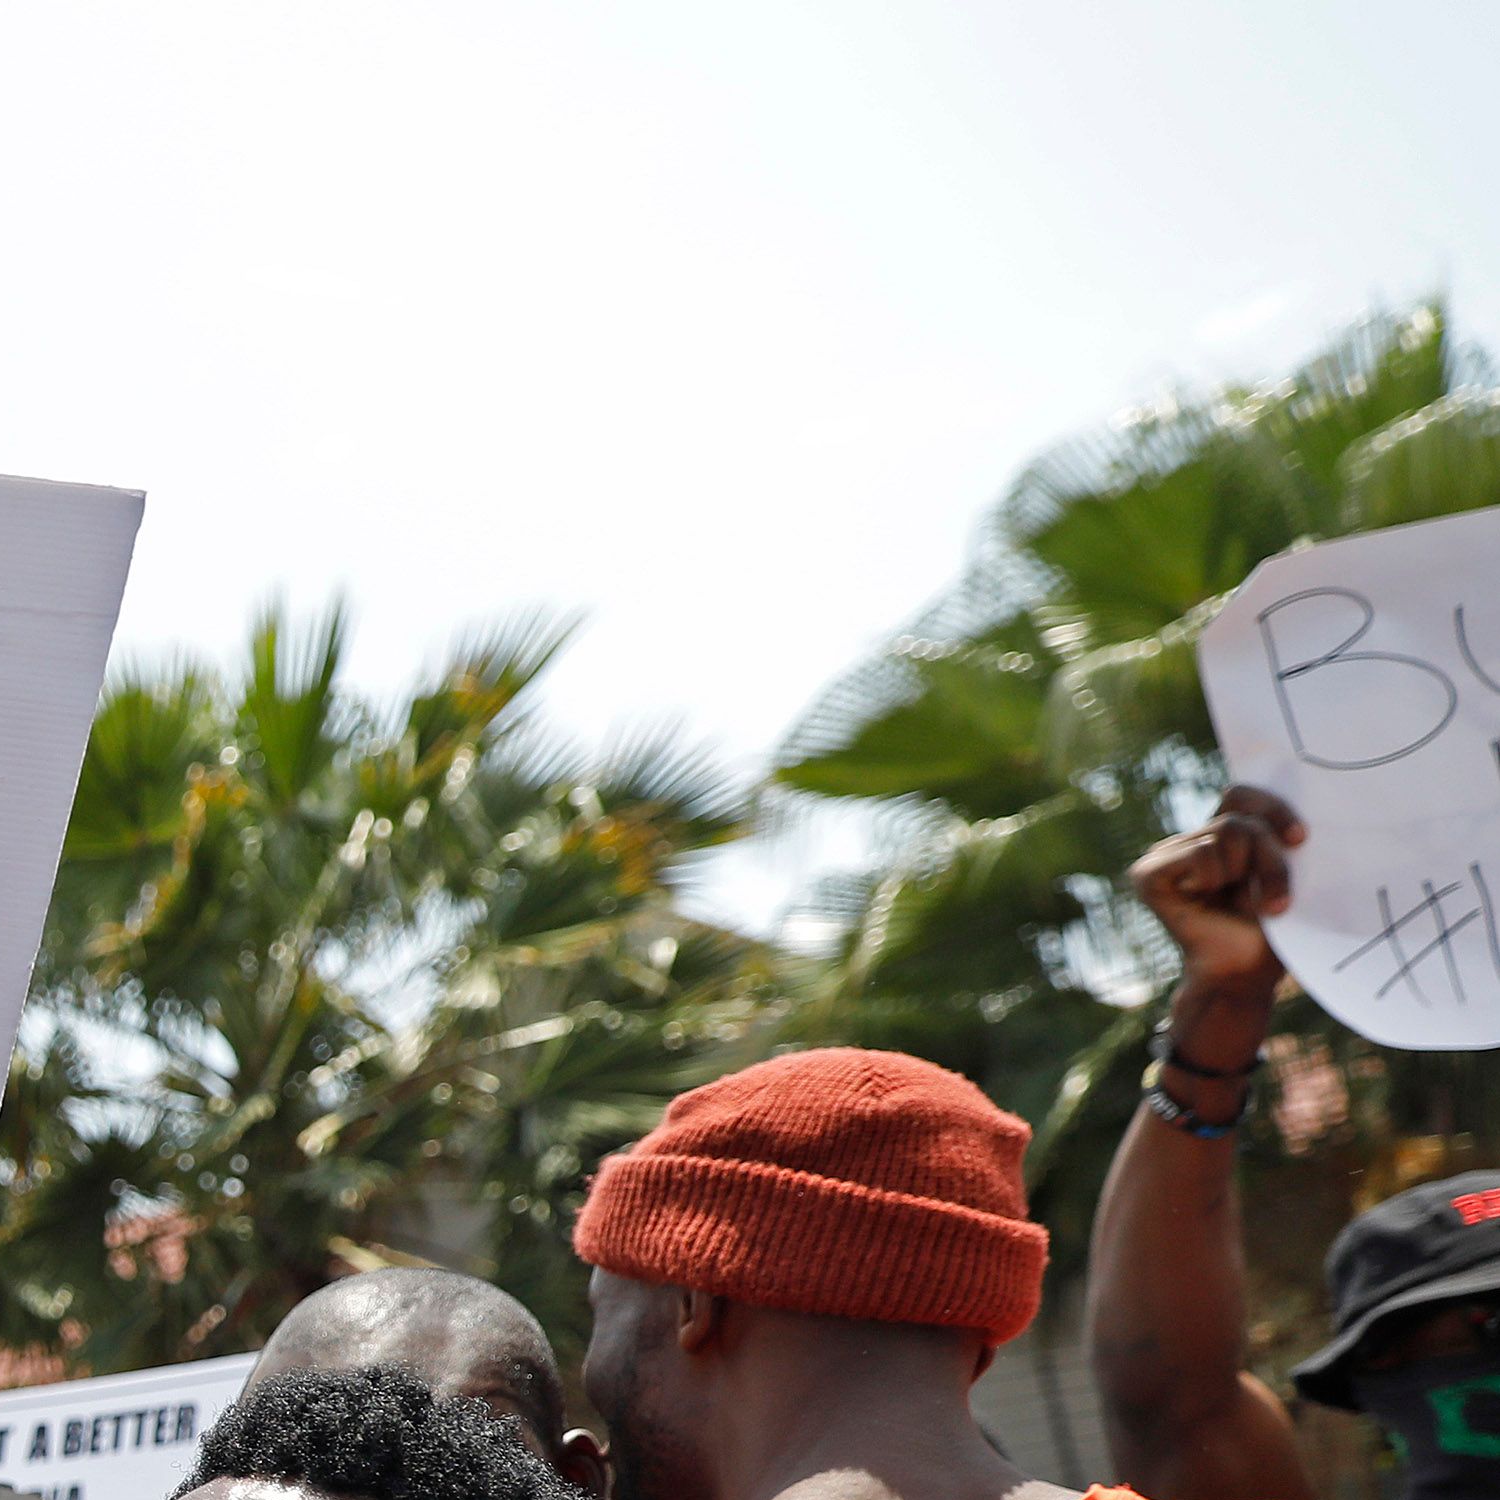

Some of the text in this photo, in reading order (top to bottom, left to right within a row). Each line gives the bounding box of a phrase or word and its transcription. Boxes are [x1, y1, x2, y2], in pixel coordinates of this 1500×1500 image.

[1257, 586, 1500, 771] B
[29, 1423, 49, 1459] A
[63, 1404, 195, 1458] BETTER
